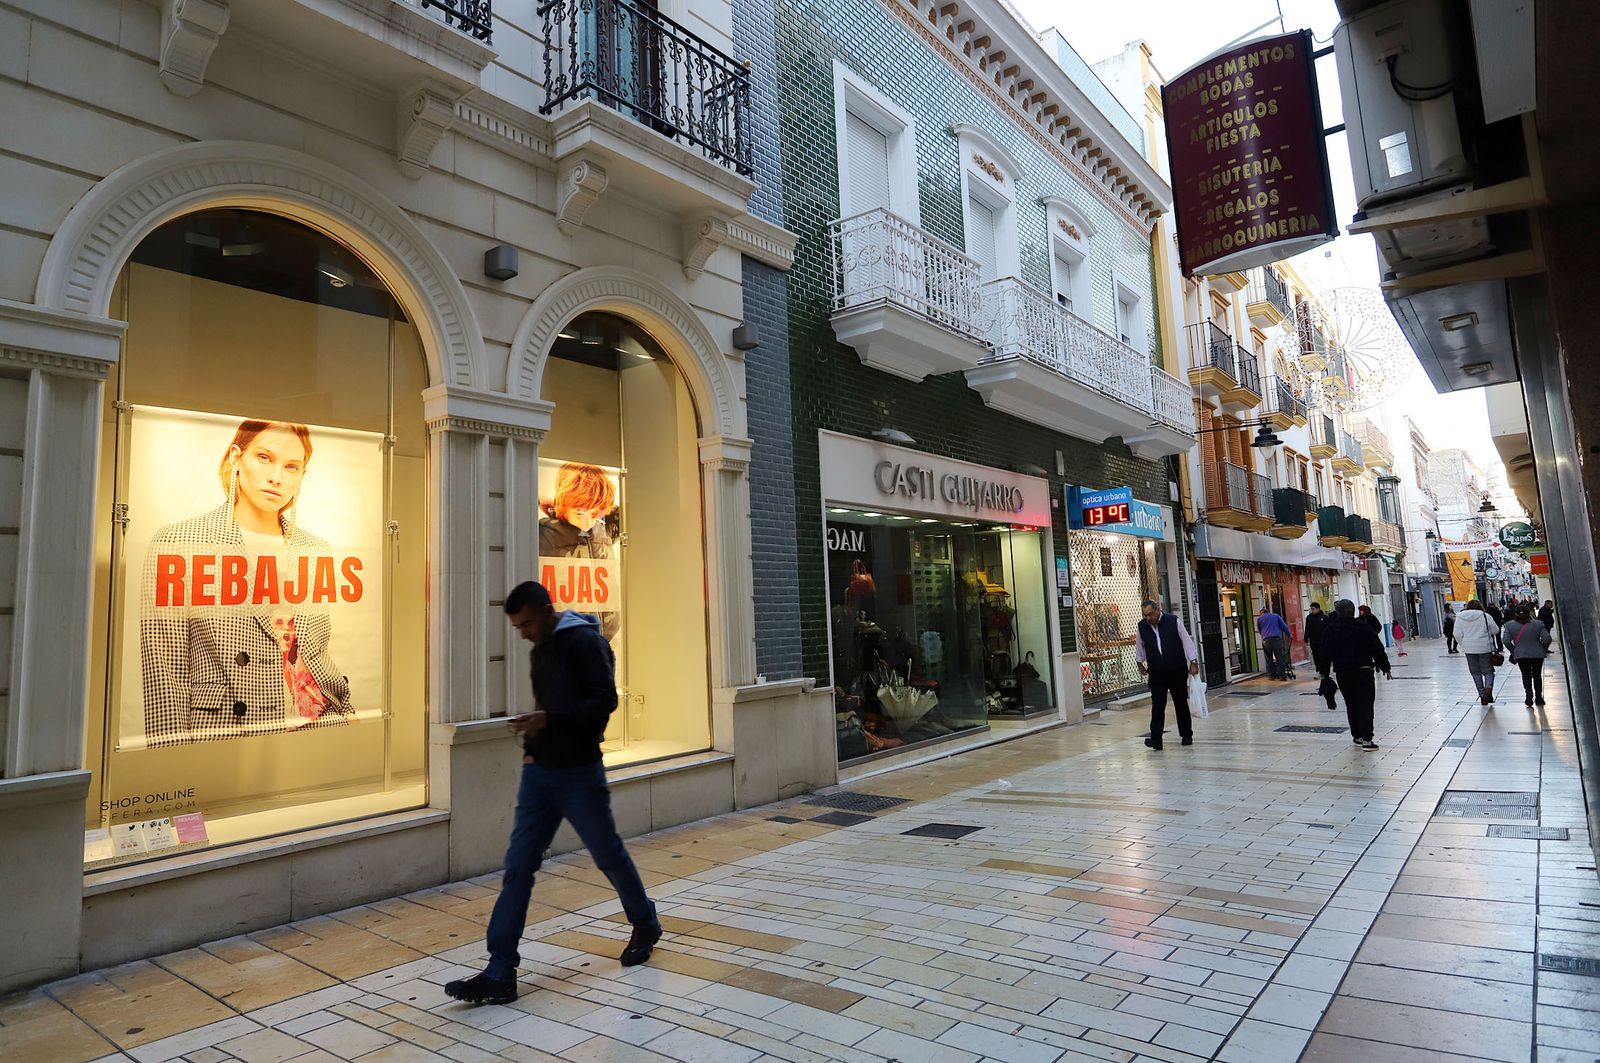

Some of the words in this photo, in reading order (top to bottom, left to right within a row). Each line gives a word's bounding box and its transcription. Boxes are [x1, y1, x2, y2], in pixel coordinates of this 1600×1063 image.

[1168, 43, 1295, 104] COMPLEMENTOS
[1199, 72, 1254, 106] BODAS
[1189, 99, 1279, 145] ARTICULOS
[1206, 123, 1261, 154] FIESTA
[1198, 156, 1282, 196] BISUTERIA
[1206, 188, 1280, 225] REGALOS
[1185, 213, 1319, 262] MARROQUINERIA
[874, 460, 936, 501] CASTI
[940, 472, 1024, 513] GUIJARRO
[1103, 492, 1127, 502] urbano
[1089, 507, 1104, 525] 13
[155, 554, 363, 607] REBAJAS
[100, 796, 141, 811] SHOP
[145, 788, 196, 804] ONLINE
[100, 800, 196, 823] SFERA.COM
